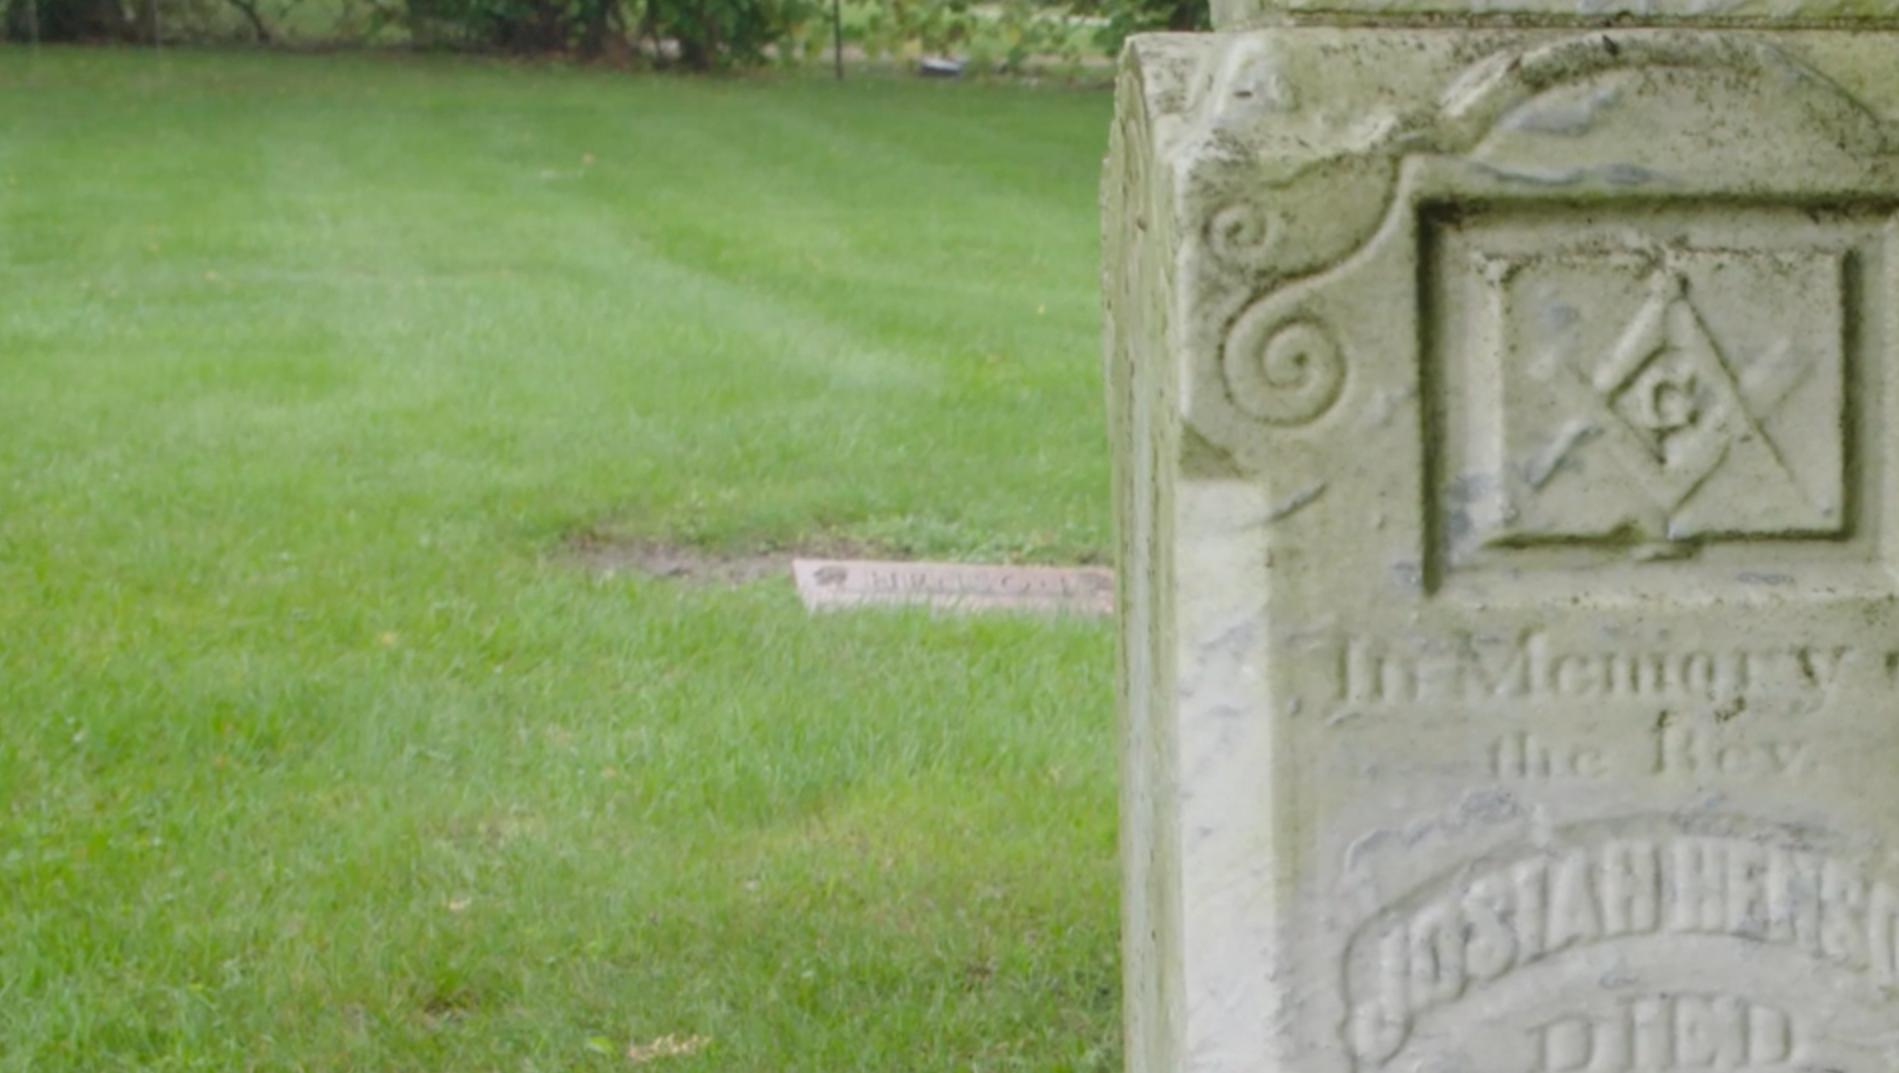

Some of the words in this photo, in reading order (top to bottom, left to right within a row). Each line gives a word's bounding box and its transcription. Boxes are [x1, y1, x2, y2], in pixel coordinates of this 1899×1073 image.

[1455, 632, 1850, 716] Memory
[1488, 730, 1610, 778] the
[1345, 845, 1660, 1070] JOSIAH
